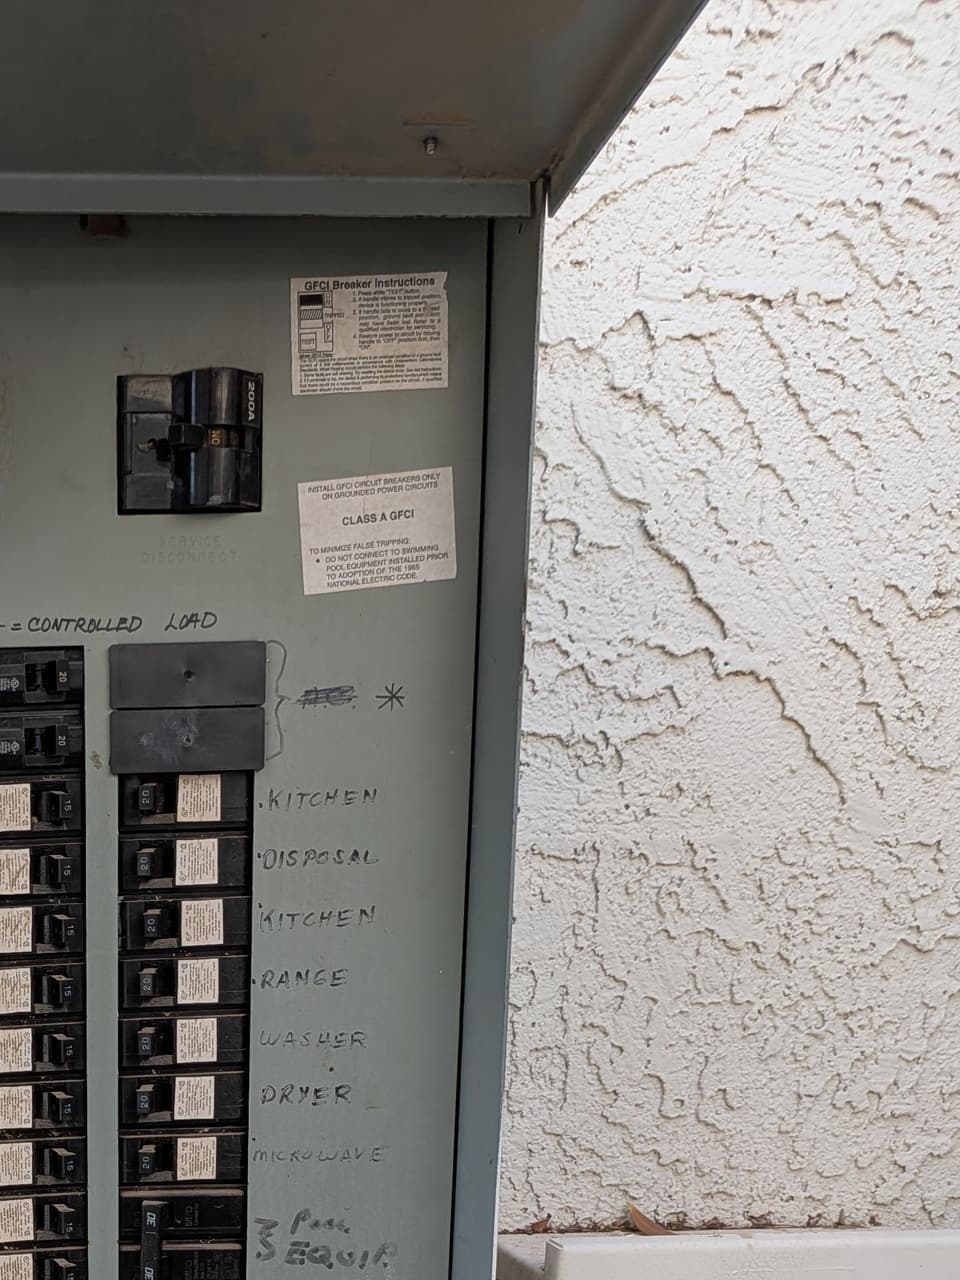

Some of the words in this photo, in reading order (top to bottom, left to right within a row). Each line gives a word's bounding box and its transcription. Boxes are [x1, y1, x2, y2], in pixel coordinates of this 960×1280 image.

[305, 281, 330, 290] GFCI
[333, 280, 371, 289] Breaker
[374, 277, 435, 288] Instructions
[247, 381, 255, 421] 200A
[308, 483, 335, 493] INSTALL
[336, 482, 353, 491] GFCI
[354, 479, 382, 488] CIRCUIT
[383, 475, 420, 486] BREAKERS
[422, 472, 440, 481] ONLY
[322, 493, 333, 501] ON
[335, 489, 375, 499] GROUNDED
[377, 486, 404, 494] POWER
[405, 482, 438, 491] CIRCUITS
[342, 514, 377, 526] CLASS
[379, 512, 387, 522] A
[390, 510, 414, 521] GFCI
[310, 547, 319, 555] TO
[353, 541, 374, 551] FALSE
[325, 556, 336, 564] DO
[338, 554, 352, 563] NOT
[354, 550, 388, 560] CONNECT
[326, 564, 345, 572] POOL
[346, 560, 387, 571] EQUIPMENT
[388, 556, 425, 567] INSTALLED
[326, 573, 337, 581] TO
[338, 569, 375, 579] ADOPTION
[376, 567, 385, 575] OF
[389, 566, 402, 574] THE
[327, 579, 360, 588] NATIONAL
[362, 574, 395, 584] ELECTRIC
[28, 614, 142, 633] CONTROLLED
[165, 611, 217, 631] LOAD
[59, 671, 67, 683] 20
[58, 735, 66, 746] 20
[142, 790, 150, 804] 20
[268, 788, 377, 811] KITCHEN
[64, 800, 72, 811] 15
[141, 856, 149, 871] 20
[262, 849, 379, 870] DISPOSAL
[63, 865, 71, 876] 15
[148, 918, 155, 932] 20
[260, 905, 376, 932] KITCHEN
[67, 925, 75, 936] 15
[144, 978, 152, 991] 20
[260, 968, 348, 989] RANGE
[64, 986, 72, 997] 15
[142, 1036, 150, 1050] 20
[259, 1030, 367, 1048] WASHER
[141, 1095, 149, 1109] 20
[261, 1084, 352, 1106] DRYER
[64, 1104, 72, 1114] 15
[142, 1156, 150, 1169] 20
[146, 1212, 156, 1228] 30
[65, 1223, 73, 1233] 15
